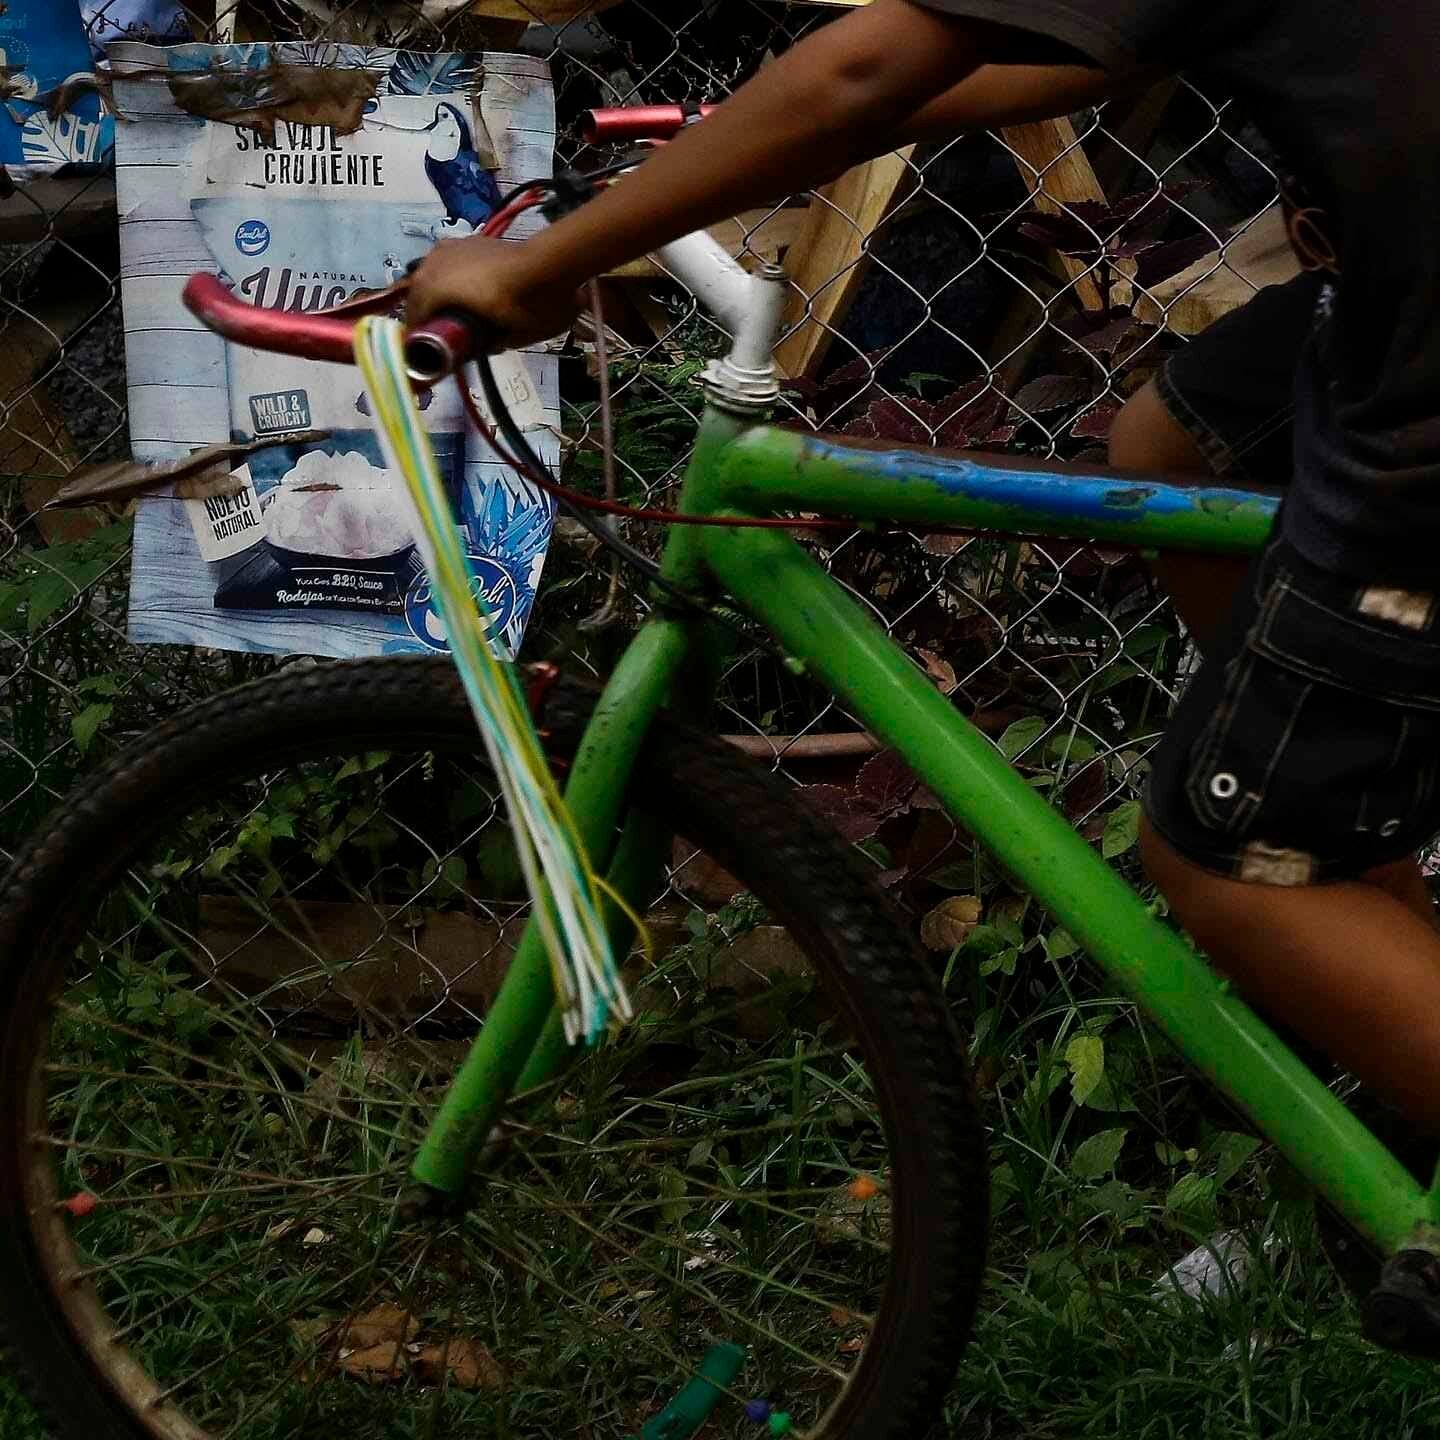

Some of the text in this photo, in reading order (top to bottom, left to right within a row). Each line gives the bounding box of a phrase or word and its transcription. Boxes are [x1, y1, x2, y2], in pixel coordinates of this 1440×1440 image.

[264, 153, 385, 187] CRUJIENTE
[299, 271, 367, 283] NATURAL
[252, 396, 288, 416] WILD
[256, 410, 308, 431] CRUNCHY
[212, 511, 260, 541] NATURAL
[276, 589, 323, 605] Rodajas
